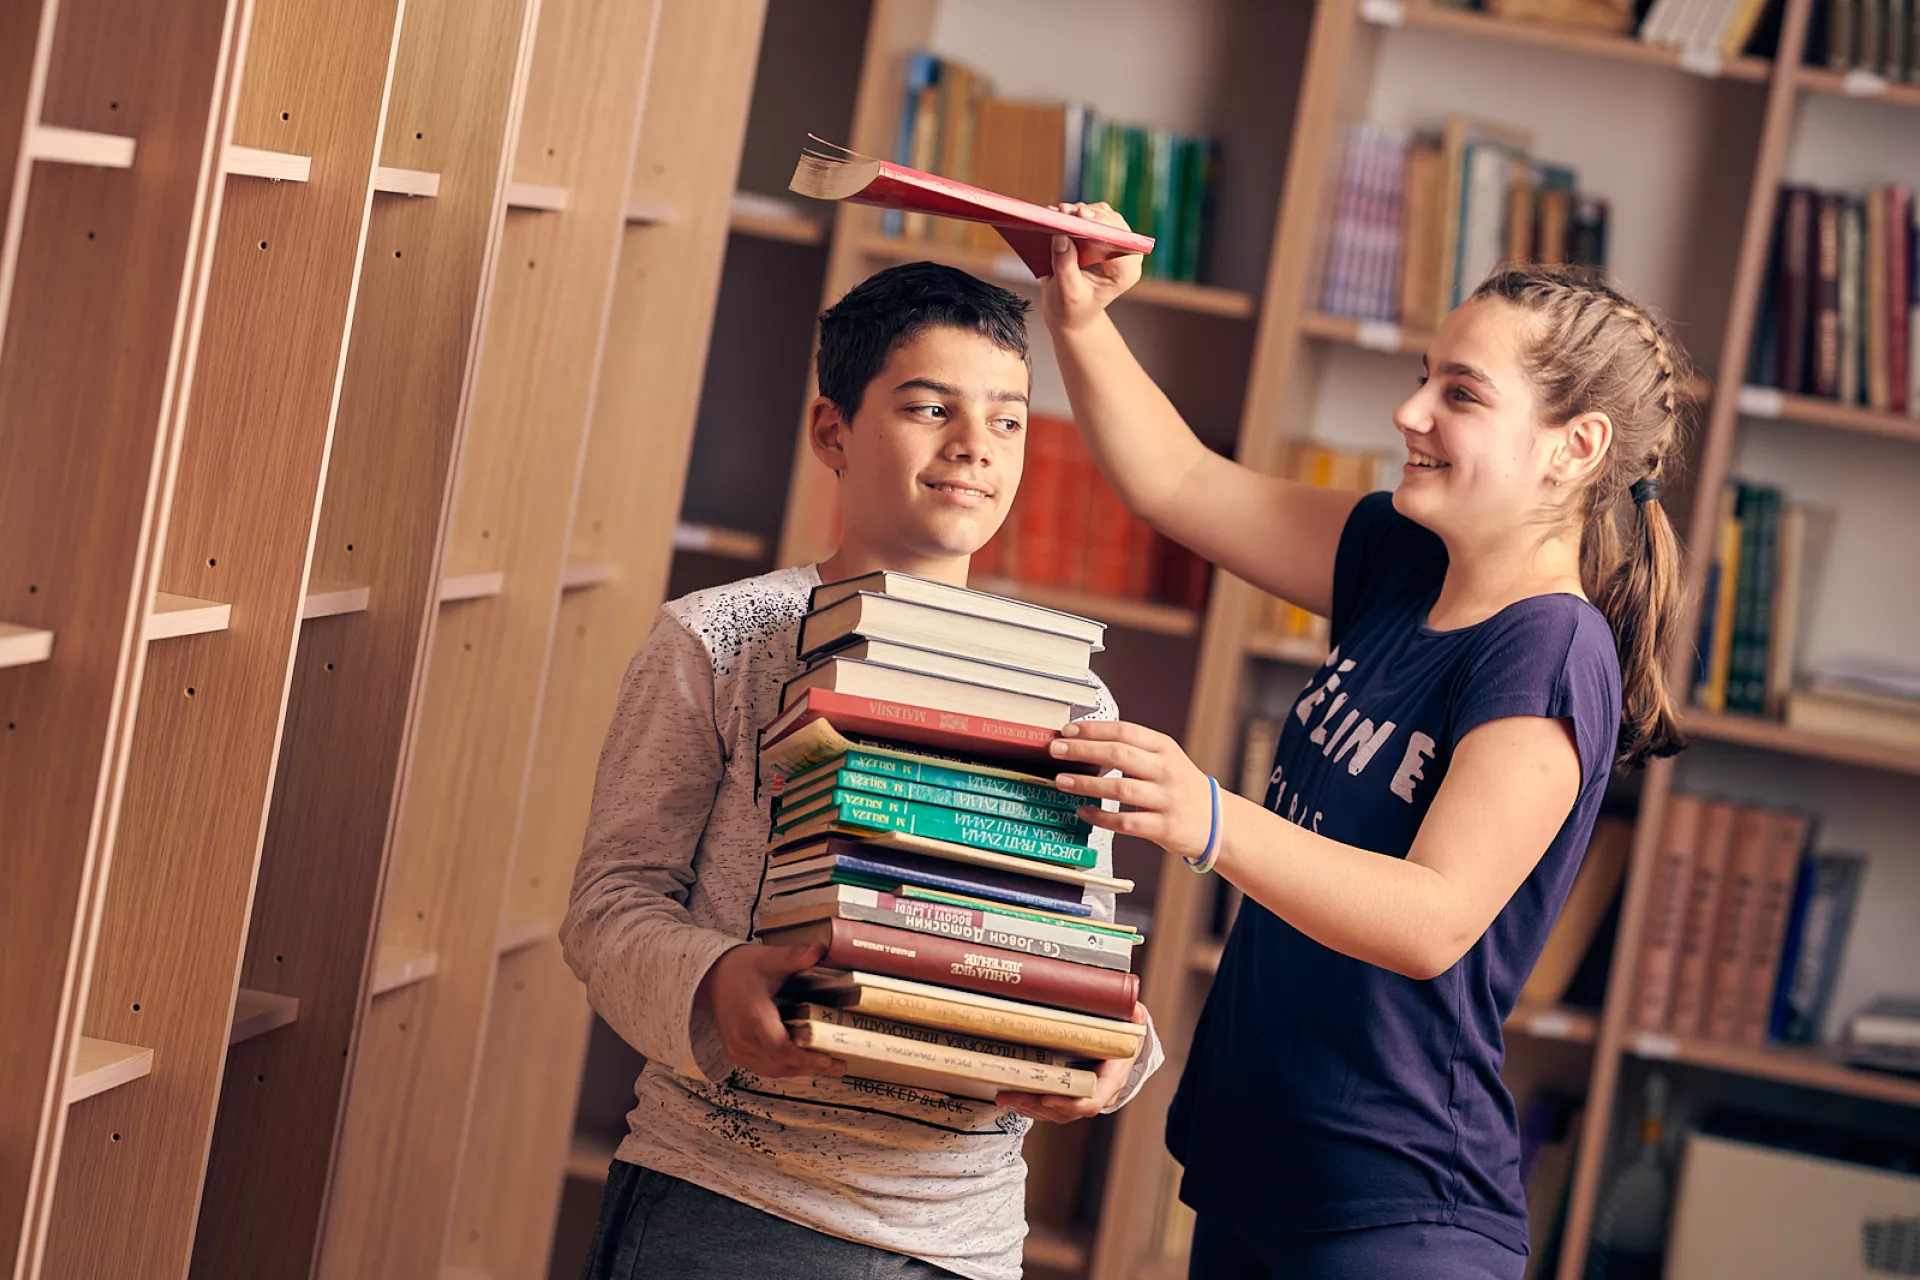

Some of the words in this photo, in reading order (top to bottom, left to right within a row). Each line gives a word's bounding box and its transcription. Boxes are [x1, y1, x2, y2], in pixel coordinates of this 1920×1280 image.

[868, 701, 926, 723] MALESIJA
[902, 764, 911, 773] M
[893, 782, 903, 792] M
[888, 802, 898, 812] M
[895, 817, 905, 826] M
[1003, 835, 1036, 852] PRATI
[894, 902, 924, 916] LJUDI
[934, 910, 972, 924] BOGOVI
[1037, 940, 1061, 957] Св.
[944, 1035, 1017, 1058] FILOZOFSKA
[854, 1080, 917, 1102] ROCKED
[919, 1094, 963, 1114] BLACK
